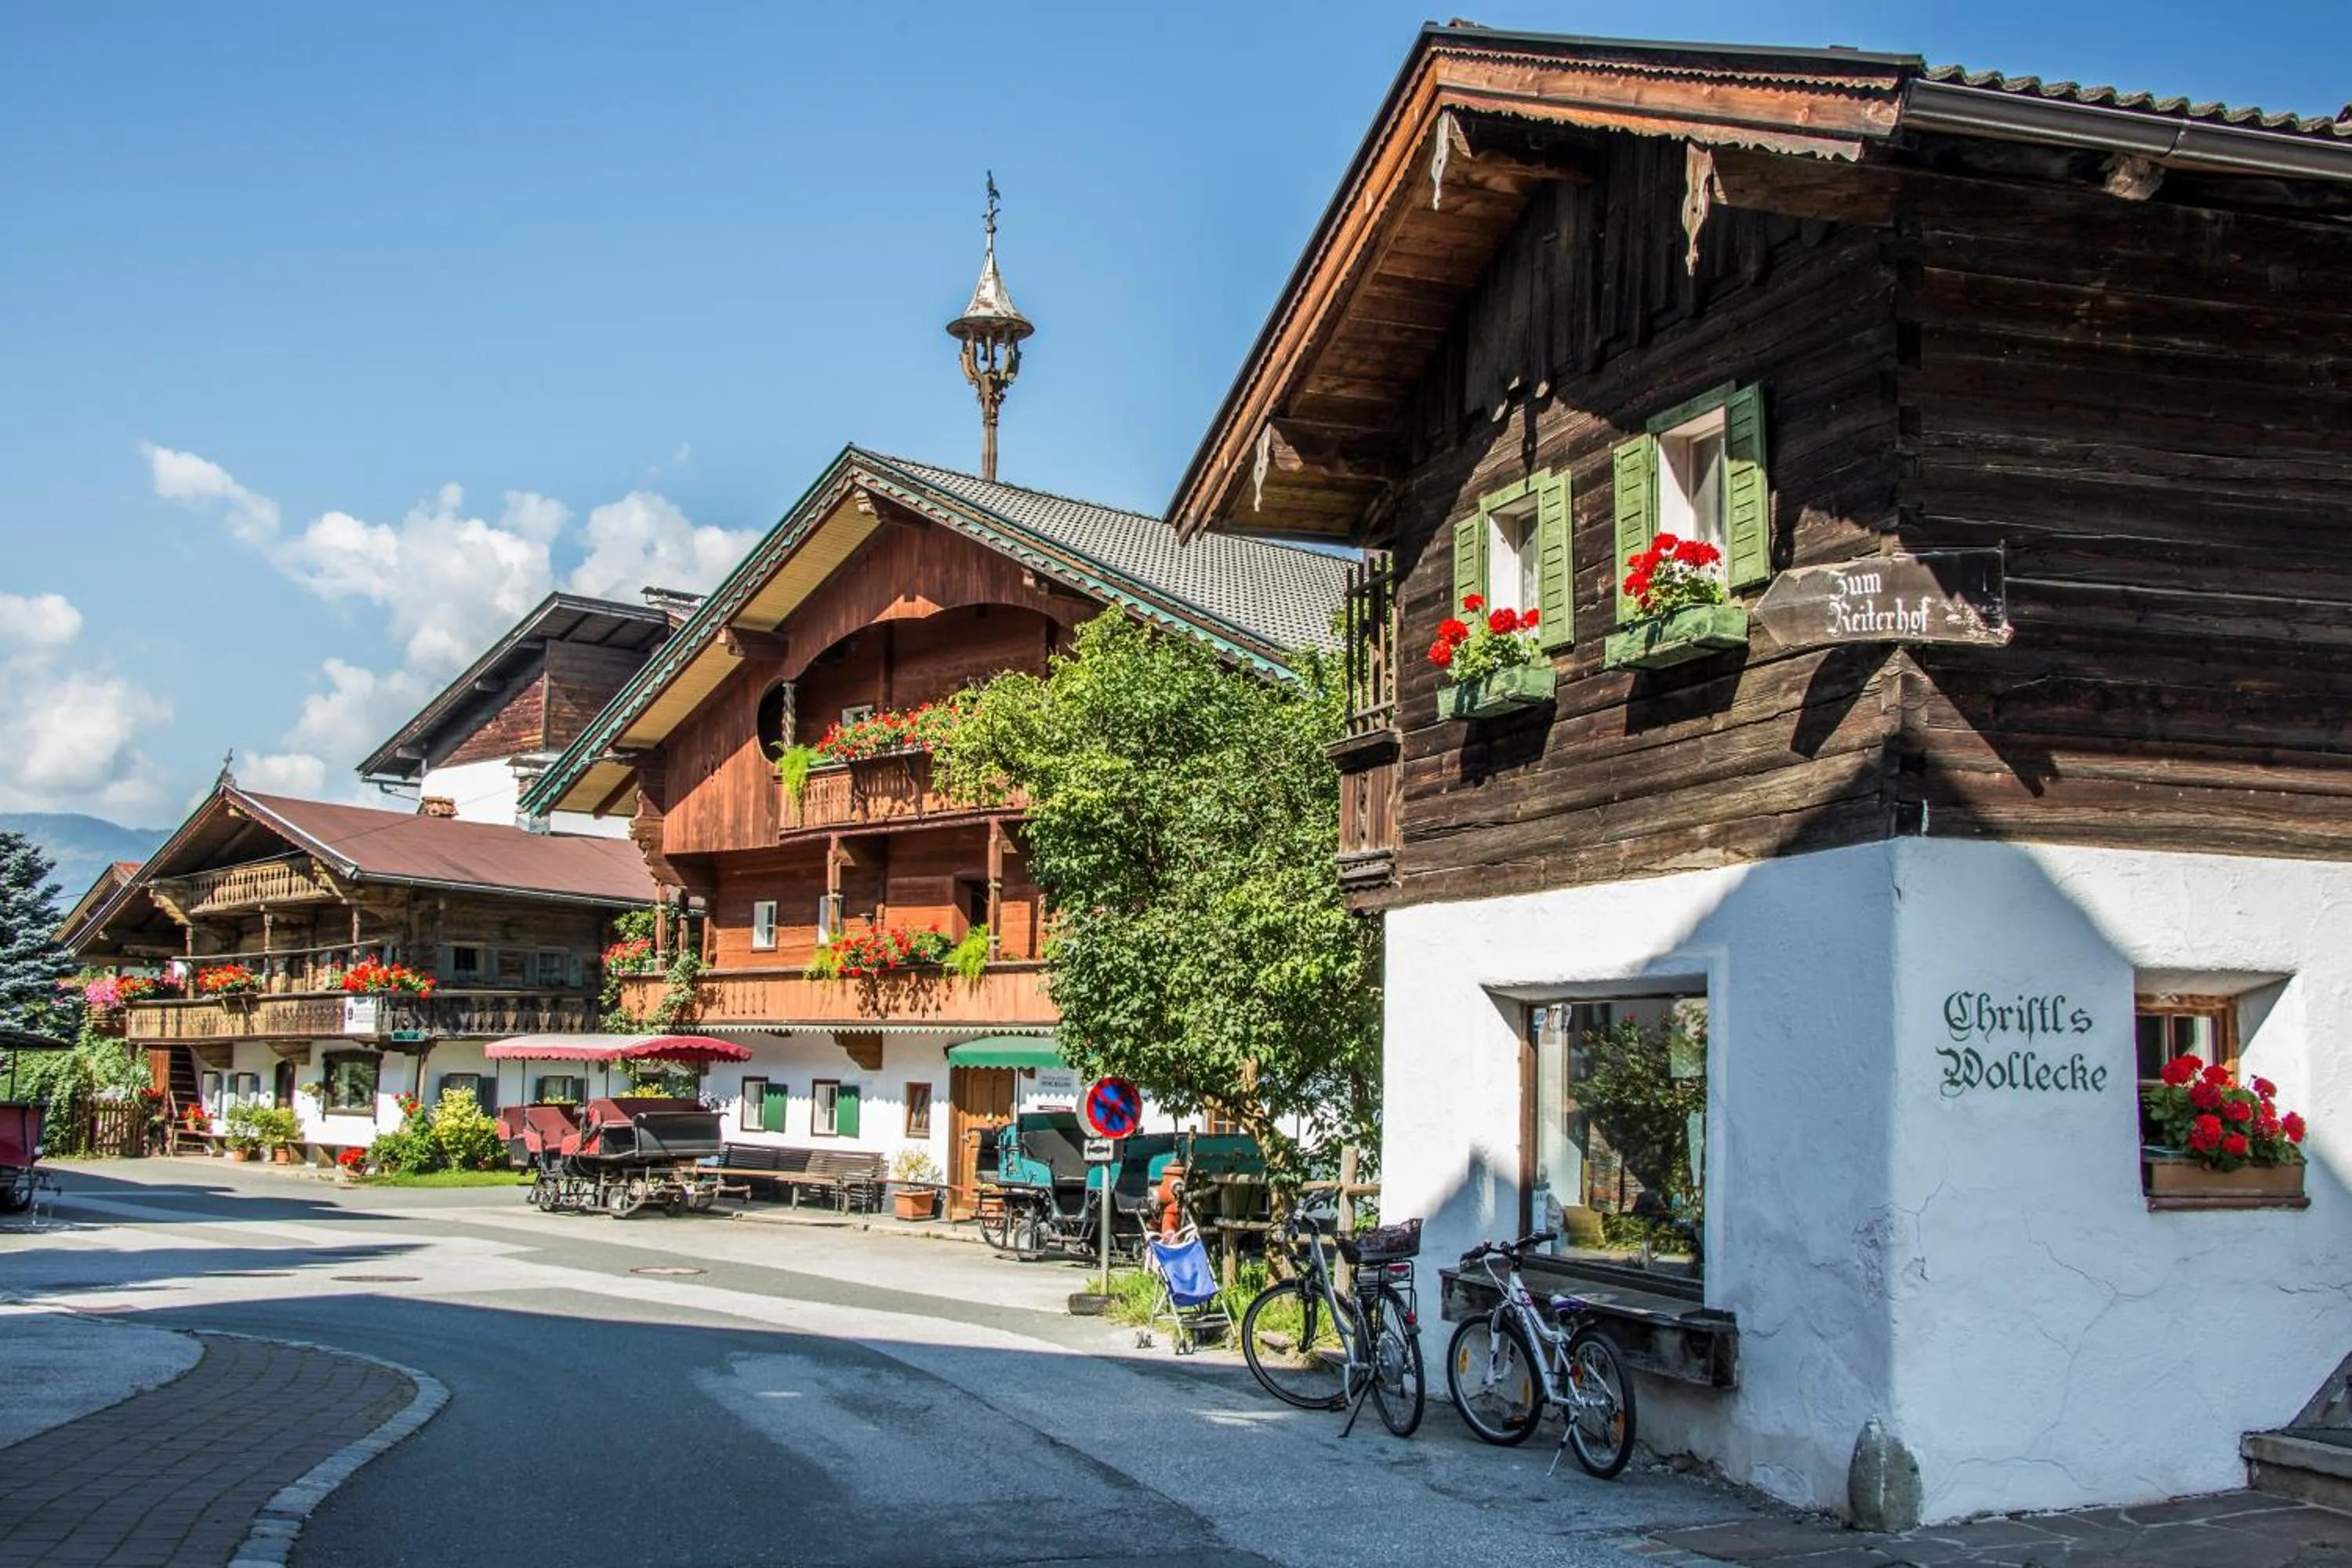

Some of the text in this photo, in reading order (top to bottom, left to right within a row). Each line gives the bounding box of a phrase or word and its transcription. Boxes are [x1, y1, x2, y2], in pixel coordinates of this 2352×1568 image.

[1829, 571, 1882, 597] Zum
[1827, 596, 1933, 637] Reiterhof
[1935, 1047, 2107, 1098] Wollecke
